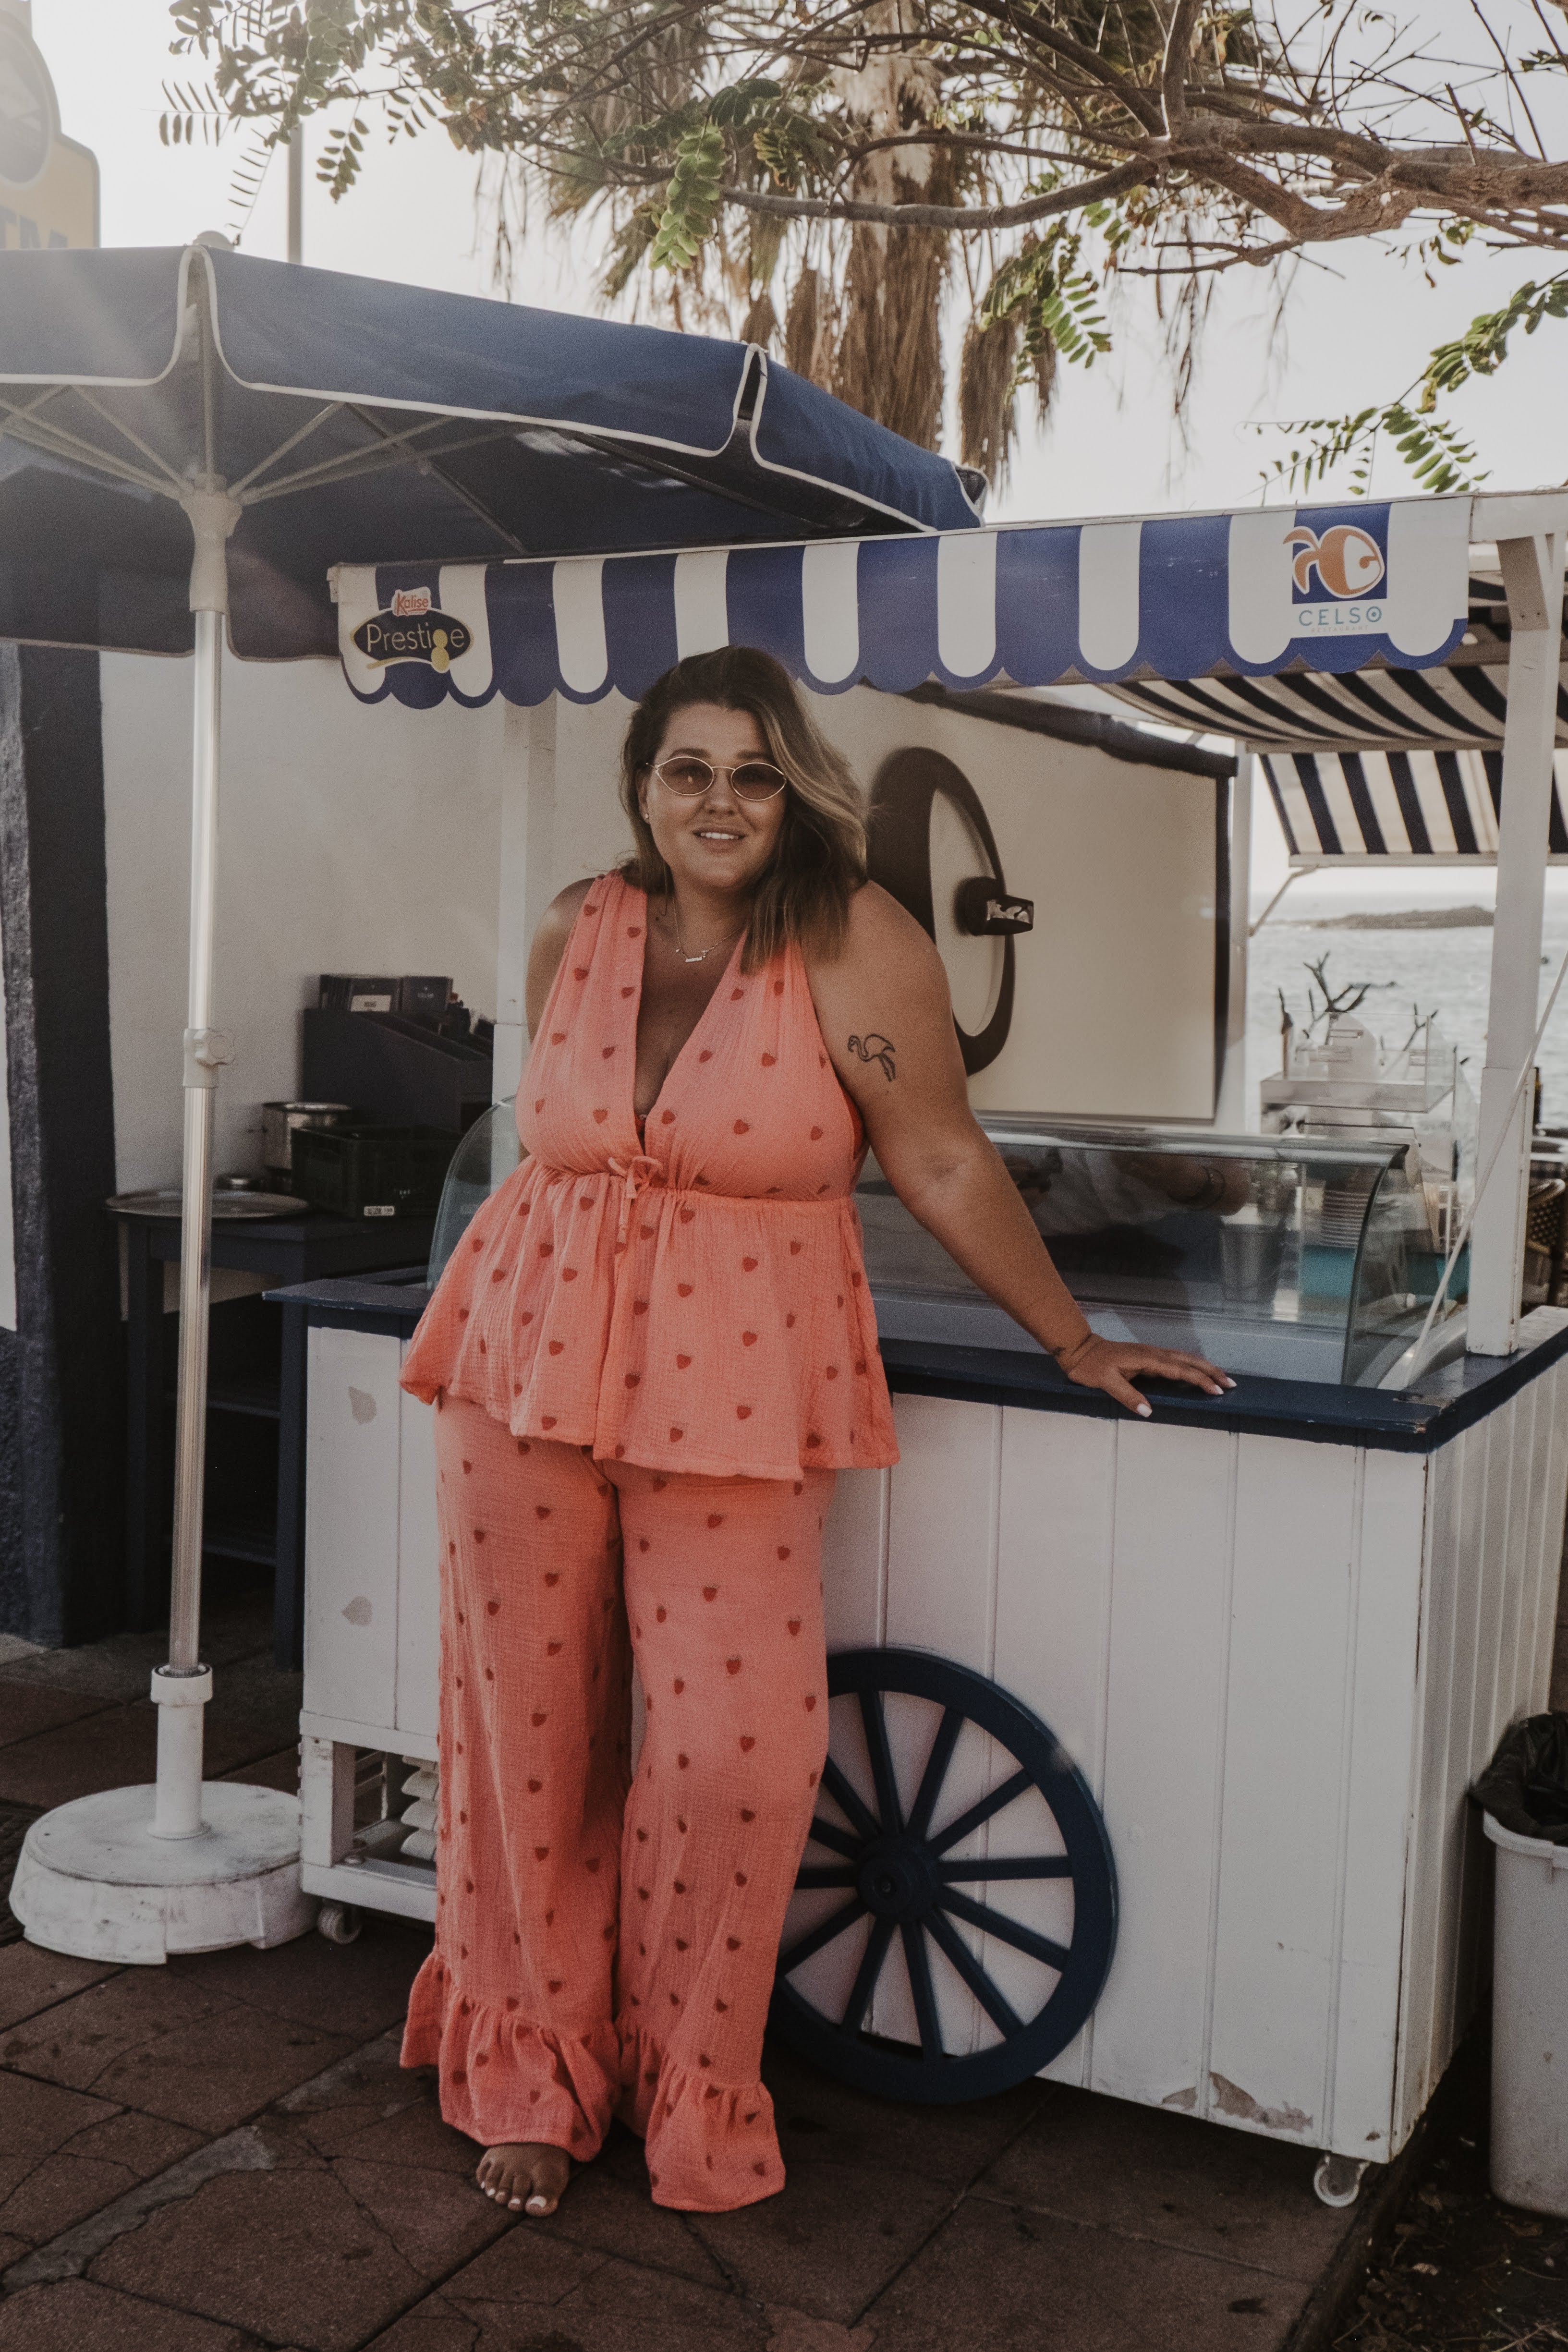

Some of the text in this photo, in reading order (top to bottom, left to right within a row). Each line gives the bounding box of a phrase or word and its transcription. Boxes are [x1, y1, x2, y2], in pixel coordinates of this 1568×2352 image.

[396, 593, 428, 616] Kalise
[1299, 606, 1382, 626] CELSO
[366, 623, 464, 671] Prestige
